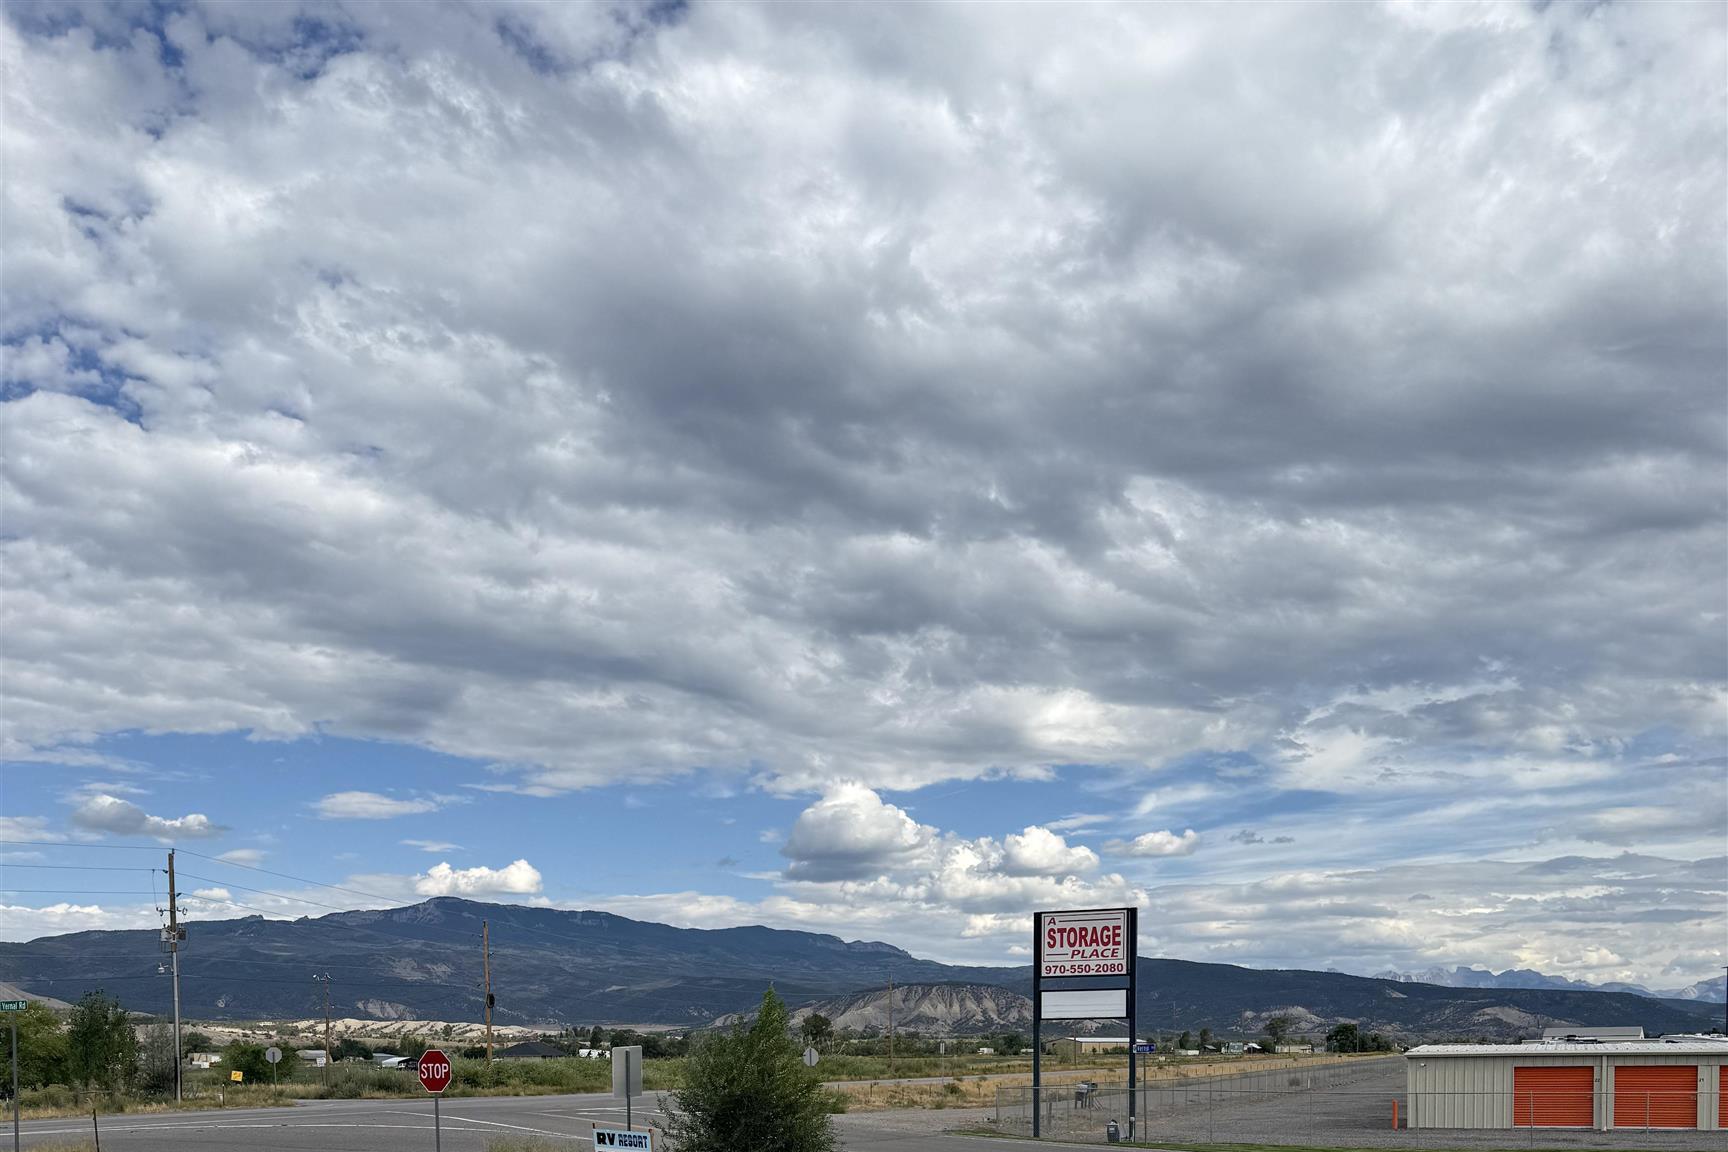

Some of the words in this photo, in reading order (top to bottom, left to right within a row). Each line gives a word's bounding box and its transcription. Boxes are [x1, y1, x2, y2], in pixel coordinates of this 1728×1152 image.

[1047, 917, 1057, 926] A
[1047, 925, 1122, 949] STORAGE
[1070, 948, 1120, 960] PLACE
[1045, 963, 1124, 975] 970-550-2080
[19, 1001, 26, 1010] Rd
[420, 1063, 449, 1079] STOP
[596, 1132, 616, 1146] RV
[618, 1133, 648, 1149] RESORT
